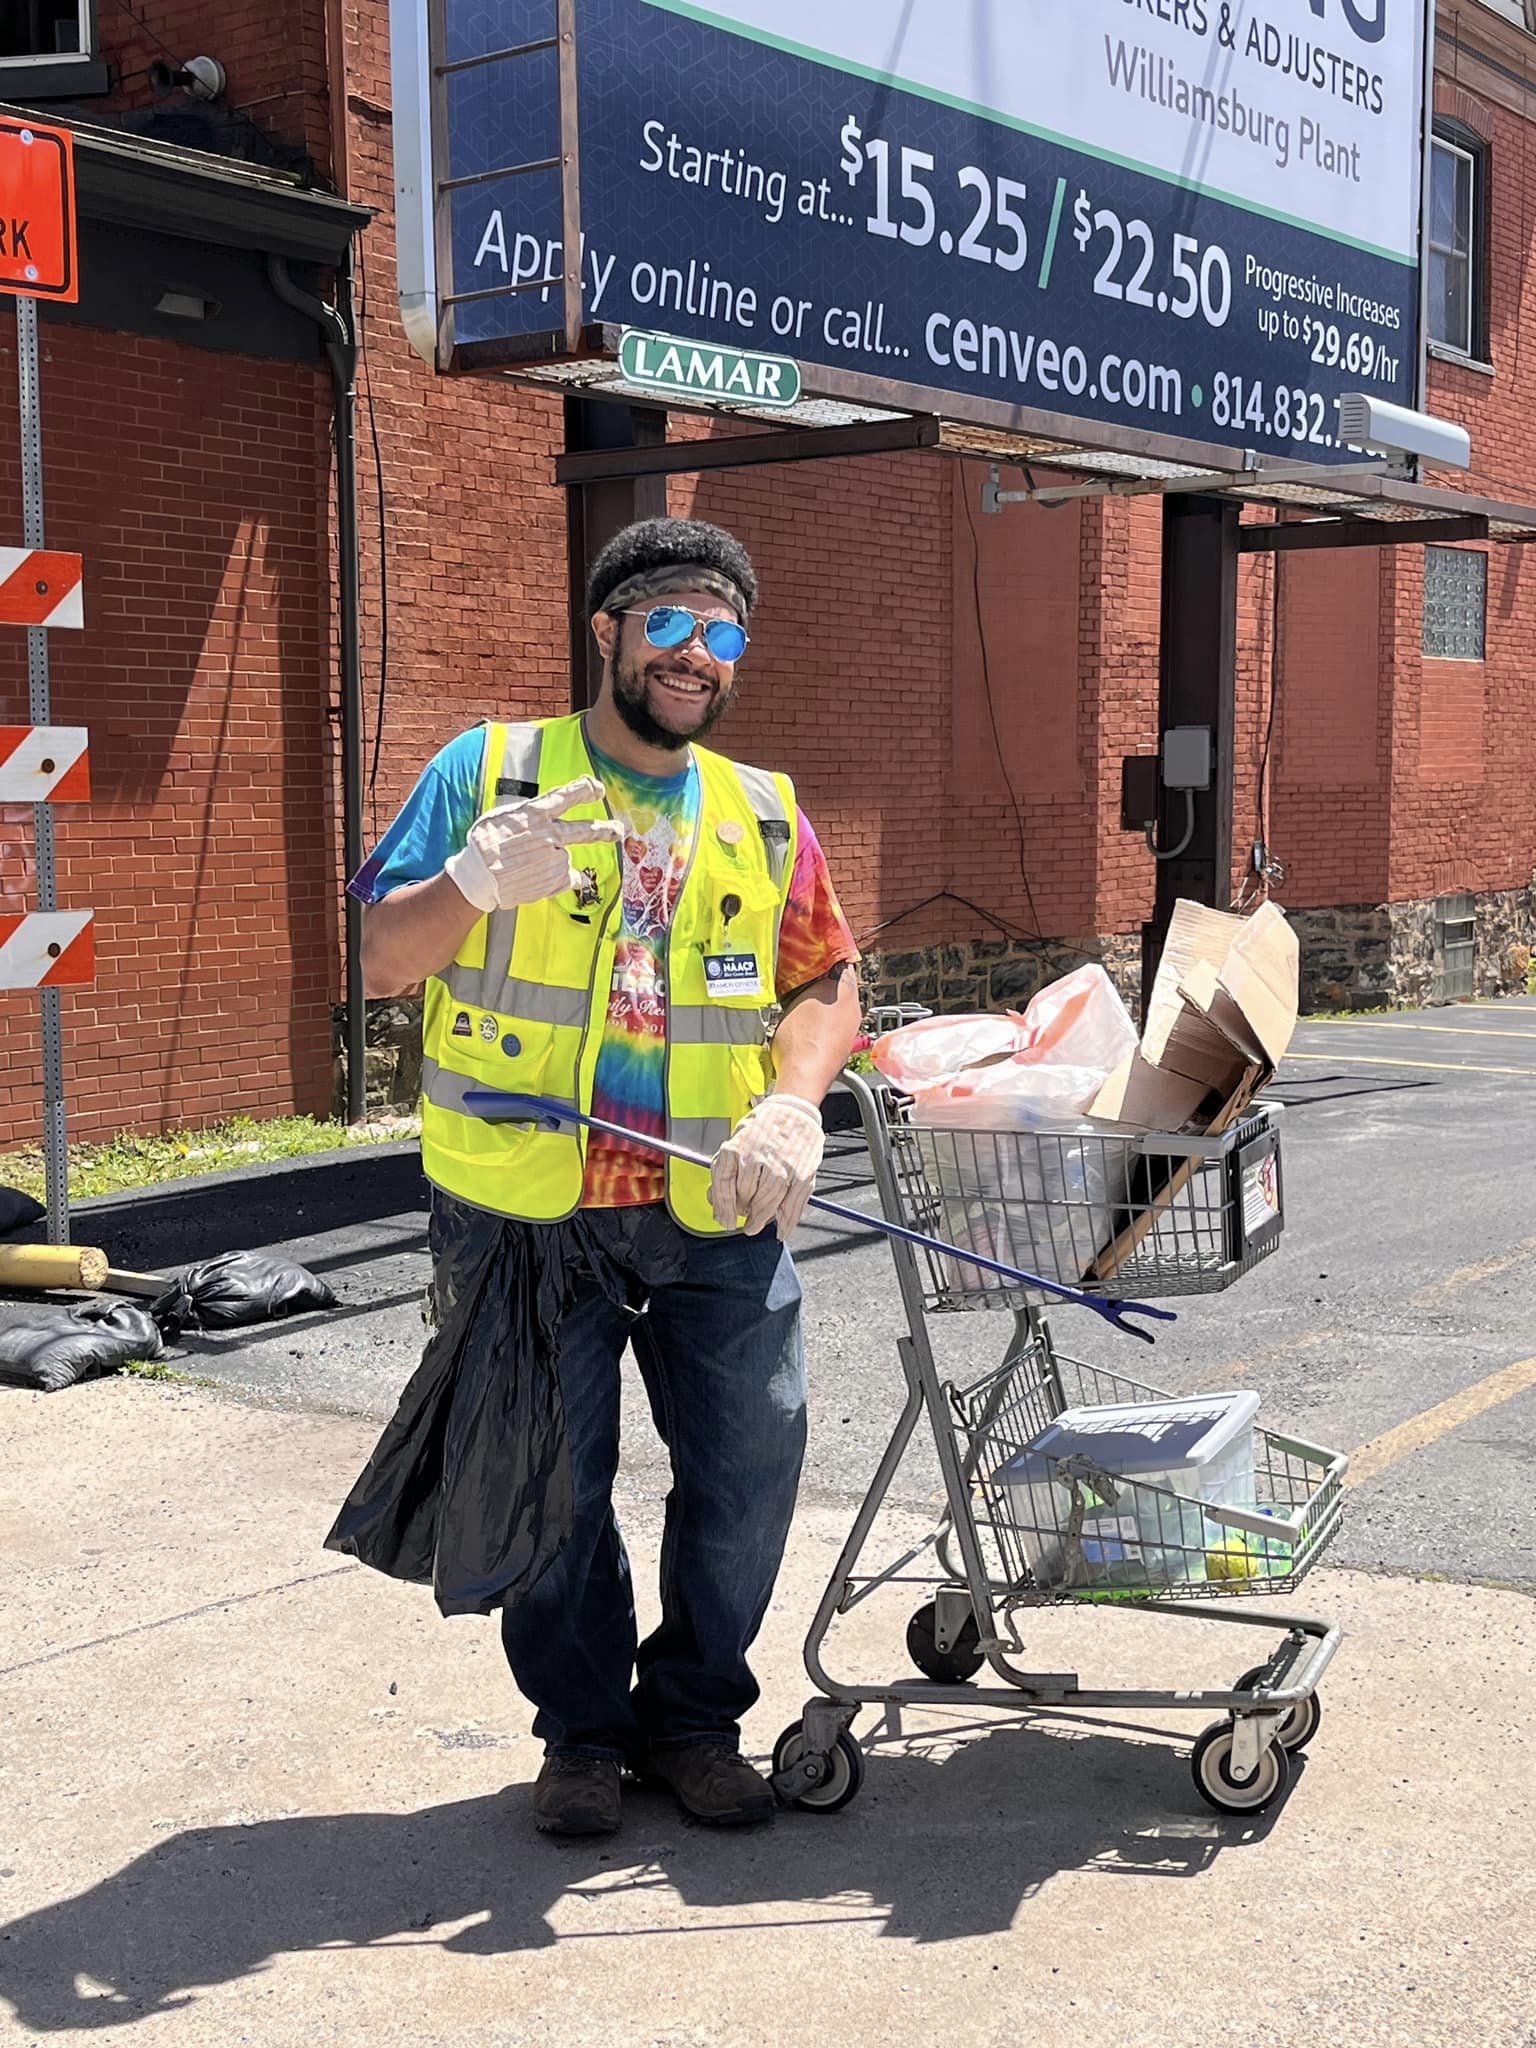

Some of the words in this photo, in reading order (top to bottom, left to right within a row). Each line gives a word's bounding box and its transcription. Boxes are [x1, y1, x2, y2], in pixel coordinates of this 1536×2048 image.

[1123, 0, 1208, 36] ERS
[1217, 1, 1236, 50] &
[1245, 17, 1384, 116] ADJUSTERS
[1104, 34, 1290, 168] Williamsburg
[1300, 116, 1361, 182] Plant
[639, 119, 787, 223] Starting
[798, 176, 854, 227] at...
[840, 114, 1029, 272] $15.25
[1073, 189, 1233, 328] $22.50
[1245, 253, 1334, 309] Progressive
[1335, 282, 1401, 330] Increases
[630, 260, 758, 328] online
[770, 295, 812, 339] or
[822, 301, 910, 359] call...
[924, 310, 1183, 416] cenveo.com
[1212, 371, 1388, 459] 814.832.
[634, 341, 782, 398] LAMAR
[1257, 308, 1280, 342] up
[1283, 311, 1300, 340] to
[1302, 314, 1400, 384] $29.69/hr
[723, 961, 754, 971] NAACP
